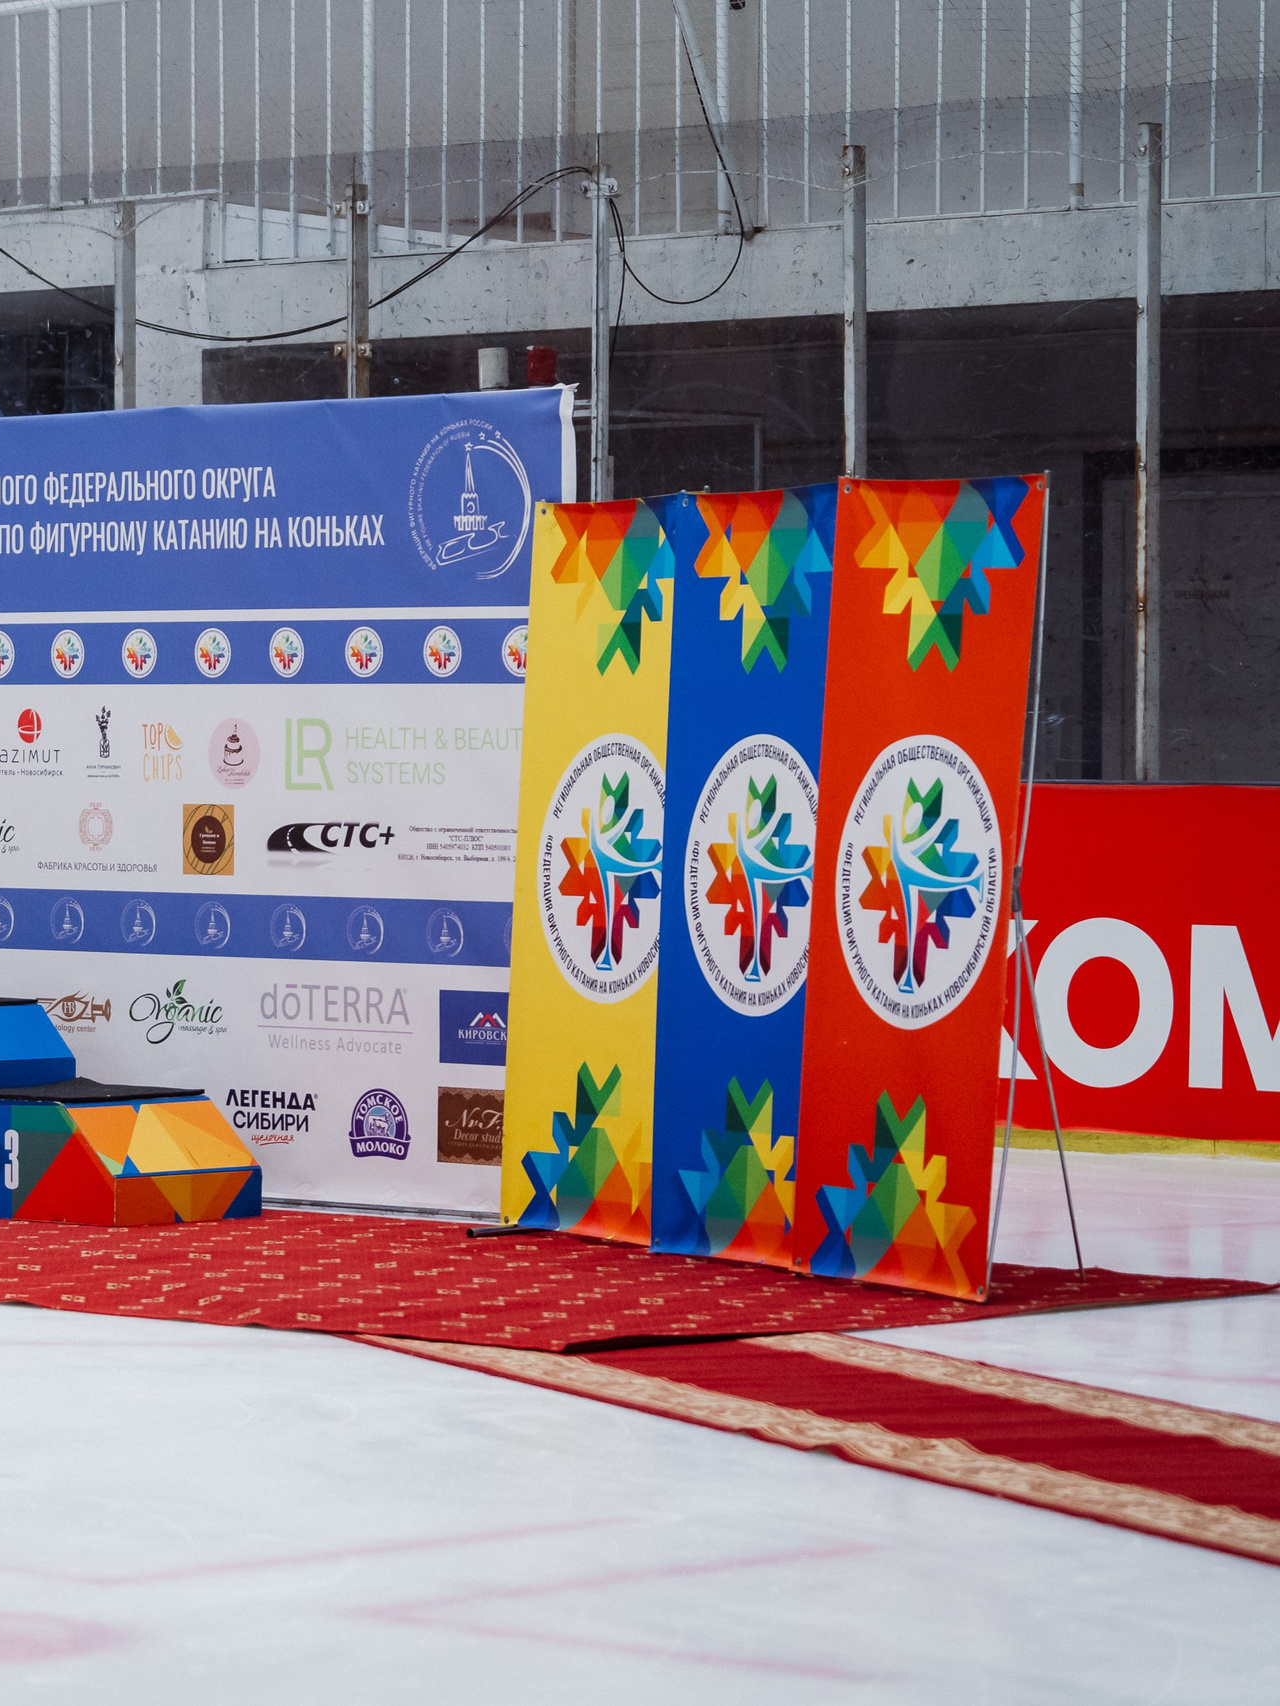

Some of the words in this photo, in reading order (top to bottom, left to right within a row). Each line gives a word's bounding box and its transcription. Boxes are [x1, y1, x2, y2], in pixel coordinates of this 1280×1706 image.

[43, 468, 196, 508] ФЕДЕРАЛЬНОГО
[202, 466, 277, 503] ОКРУГА
[30, 520, 148, 557] ФИГУРНОМУ
[154, 517, 248, 552] КАТАНИЮ
[254, 517, 283, 549] НА
[288, 514, 386, 548] КОНЬКАХ
[142, 722, 163, 751] TOP
[346, 727, 427, 750] HEALTH
[435, 727, 448, 750] &
[143, 753, 183, 782] CHIPS
[285, 718, 335, 791] LR
[21, 768, 64, 777] Новосибирск
[347, 762, 445, 785] SYSTEMS
[854, 758, 896, 826] РЕГИОНАЛЬНАЯ
[897, 744, 957, 770] ОБЩЕСТВЕННАЯ
[957, 761, 993, 834] ОРГАНИЗАЦИЯ
[37, 861, 73, 871] ФАБРИКА
[74, 862, 109, 872] КРАСОТЫ
[110, 863, 115, 872] И
[117, 862, 157, 873] ЗДОРОВЬЯ
[846, 927, 873, 991] ФИГУРНОГО
[871, 985, 902, 1017] КАТАНИЯ
[901, 1003, 911, 1019] НА
[910, 993, 945, 1020] КОНЬКАХ
[944, 914, 992, 1004] НОВОСИБИРСКОЙ
[77, 1025, 96, 1033] center
[129, 993, 223, 1044] Organic
[268, 1033, 331, 1051] Wellness
[337, 1036, 402, 1055] Advocate
[226, 1089, 316, 1111] ЛЕГЕНДА
[356, 1093, 402, 1124] ТОМСКОЕ
[233, 1110, 309, 1133] СИБИРИ
[453, 1128, 479, 1142] Decor
[4, 1129, 19, 1190] 3
[356, 1141, 405, 1157] МОЛОКО
